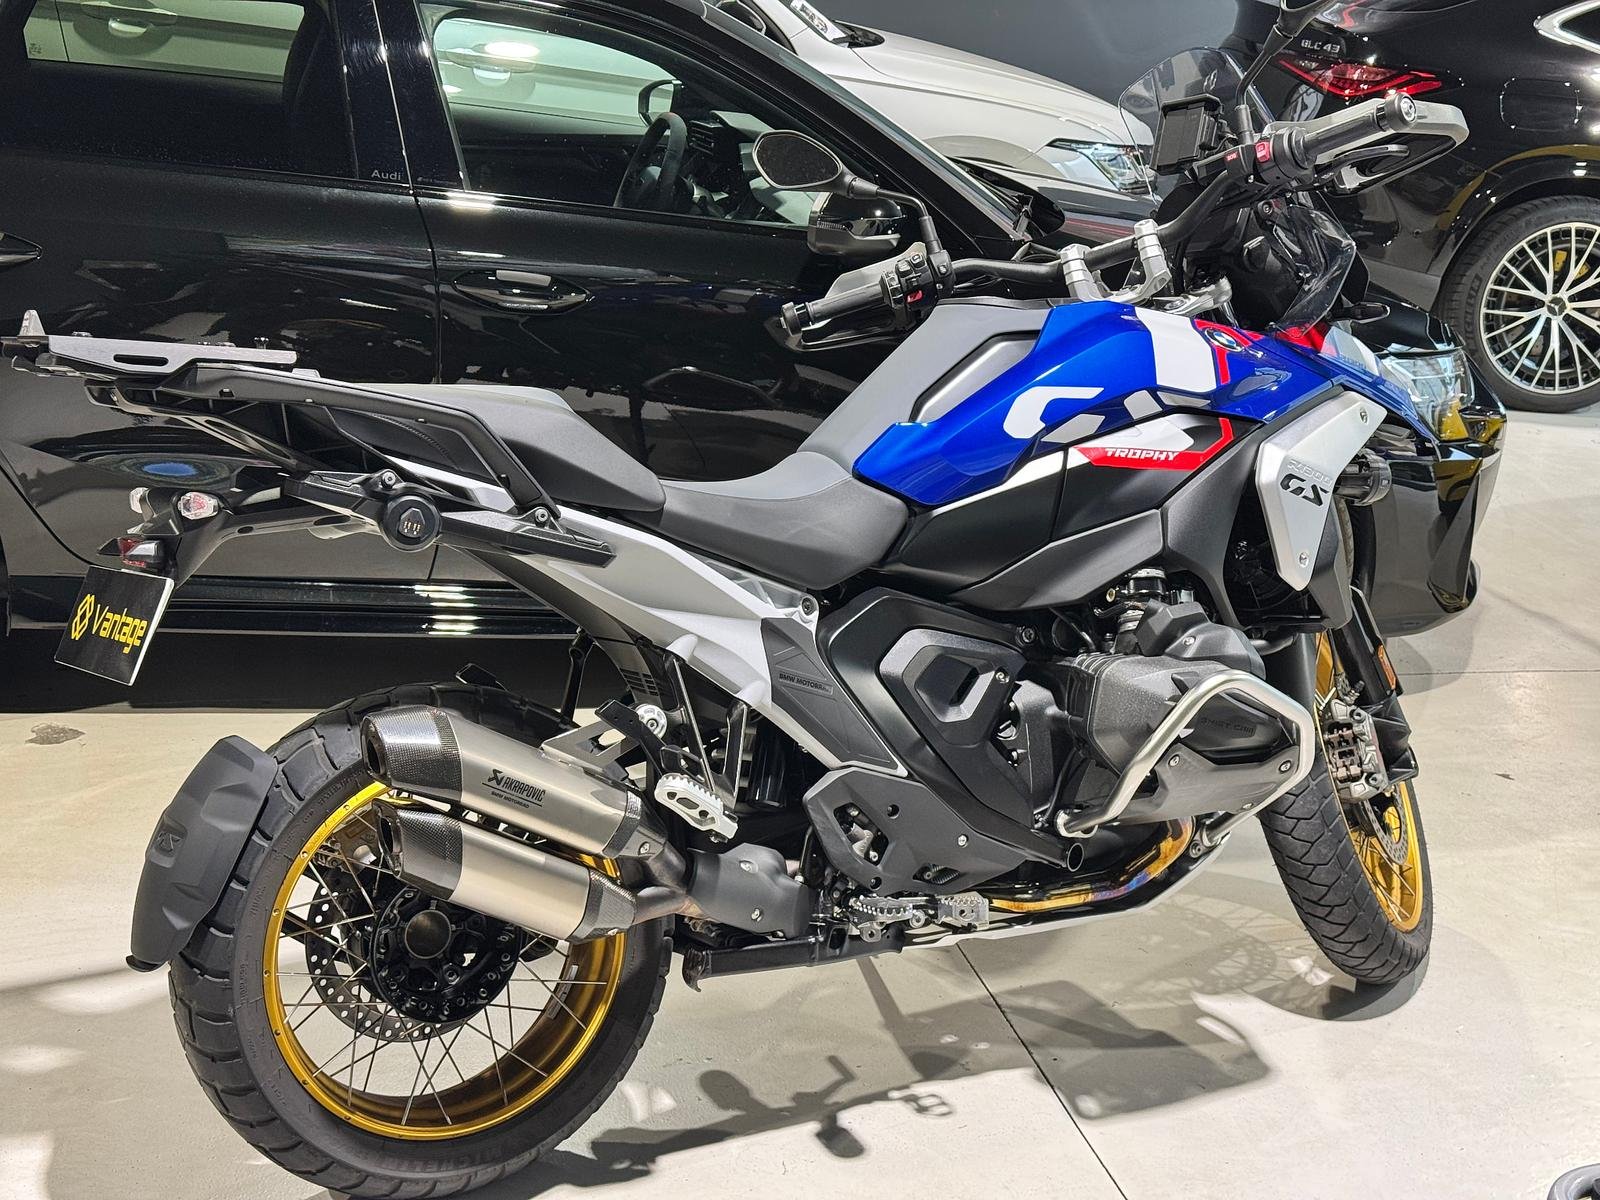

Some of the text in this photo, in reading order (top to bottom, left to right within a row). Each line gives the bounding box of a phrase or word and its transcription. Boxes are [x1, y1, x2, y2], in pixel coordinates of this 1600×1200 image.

[1301, 39, 1340, 53] GLC 43
[371, 169, 401, 181] Audi
[1105, 448, 1178, 461] TROPHY
[1280, 473, 1329, 506] GS
[92, 604, 148, 653] Vantage
[779, 673, 795, 682] BMW
